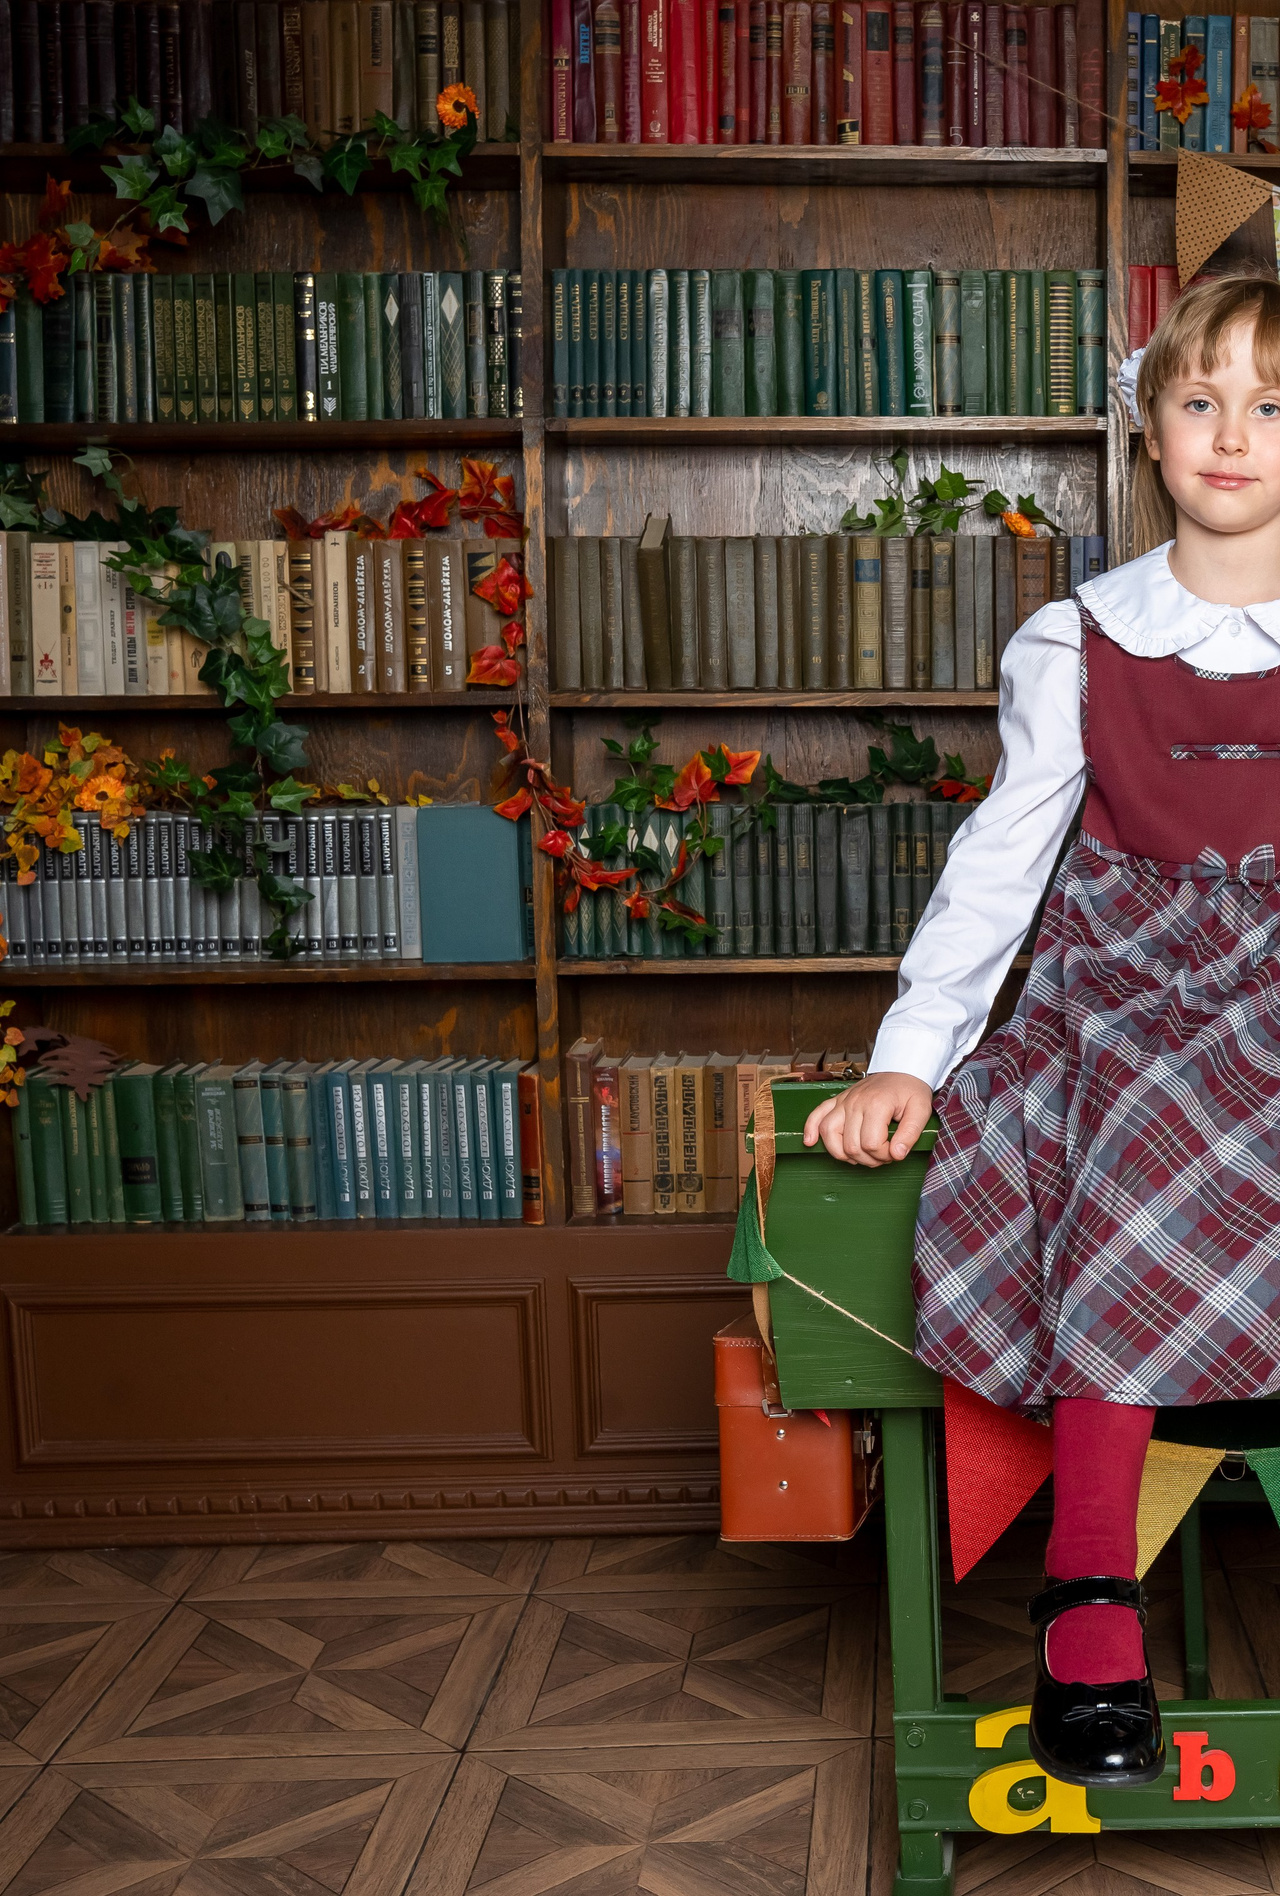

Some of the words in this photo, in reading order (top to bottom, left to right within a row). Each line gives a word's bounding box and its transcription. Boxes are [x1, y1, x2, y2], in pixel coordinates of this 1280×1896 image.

[579, 23, 591, 64] ВЕТЕР
[555, 283, 564, 341] СТЕНДАЛЬ
[571, 284, 580, 341] СТЕНДАЛЬ
[589, 282, 598, 340] СТЕНДАЛЬ
[620, 282, 629, 340] СТЕНДАЛЬ
[913, 289, 923, 327] САНД
[913, 332, 924, 372] ЖОРЖ
[355, 555, 366, 651] ШОЛОМ-АЛЕЙХЕМ
[441, 556, 453, 652] ШОЛОМ-АЛЕЙХЕМ
[809, 553, 819, 607] ТОЛСТОЙ
[836, 552, 846, 607] ТОЛСТОЙ
[382, 558, 393, 654] ШОЛОМ-АЛЕЙХЕМ
[127, 636, 137, 658] ГОДЫ
[358, 665, 365, 674] 2
[386, 667, 393, 676] 3
[445, 665, 452, 675] 5
[128, 667, 138, 683] ДНИ
[92, 827, 101, 876] М.ГОРЬКИЙ
[130, 826, 138, 875] М.ГОРЬКИЙ
[146, 826, 155, 875] М.ГОРЬКИЙ
[160, 825, 169, 874] М.ГОРЬКИЙ
[177, 824, 185, 874] М.ГОРЬКИЙ
[308, 824, 317, 874] М.ГОРЬКИЙ
[324, 823, 333, 873] М.ГОРЬКИЙ
[342, 822, 351, 872] М.ГОРЬКИЙ
[362, 822, 371, 872] М.ГОРЬКИЙ
[381, 821, 391, 871] М.ГОРЬКИЙ
[334, 1088, 346, 1157] ГОЛСУОРСИ
[353, 1086, 366, 1154] ГОЛСУОРСИ
[375, 1086, 388, 1154] ГОЛСУОРСИ
[401, 1086, 411, 1154] ГОЛСУОРСИ
[421, 1086, 431, 1153] ГОЛСУОРСИ
[440, 1086, 450, 1153] ГОЛСУОРСИ
[456, 1087, 469, 1155] ГОЛСУОРСИ
[478, 1087, 490, 1154] ГОЛСУОРСИ
[503, 1085, 513, 1153] ГОЛСУОРСИ
[629, 1074, 641, 1132] К.ПАУСТОВСКИЙ
[653, 1074, 675, 1193] СТЕНДАЛЬ
[677, 1074, 703, 1193] СТЕНДАЛЬ
[339, 1160, 351, 1192] ДЖОН
[358, 1158, 369, 1190] ДЖОН
[380, 1158, 391, 1190] ДЖОН
[403, 1158, 414, 1190] ДЖОН
[423, 1157, 433, 1189] ДЖОН
[441, 1157, 452, 1189] ДЖОН
[461, 1158, 472, 1190] ДЖОН
[482, 1158, 493, 1190] ДЖОН
[504, 1156, 515, 1189] ДЖОН
[967, 1704, 1101, 1835] a
[1172, 1730, 1237, 1802] b
